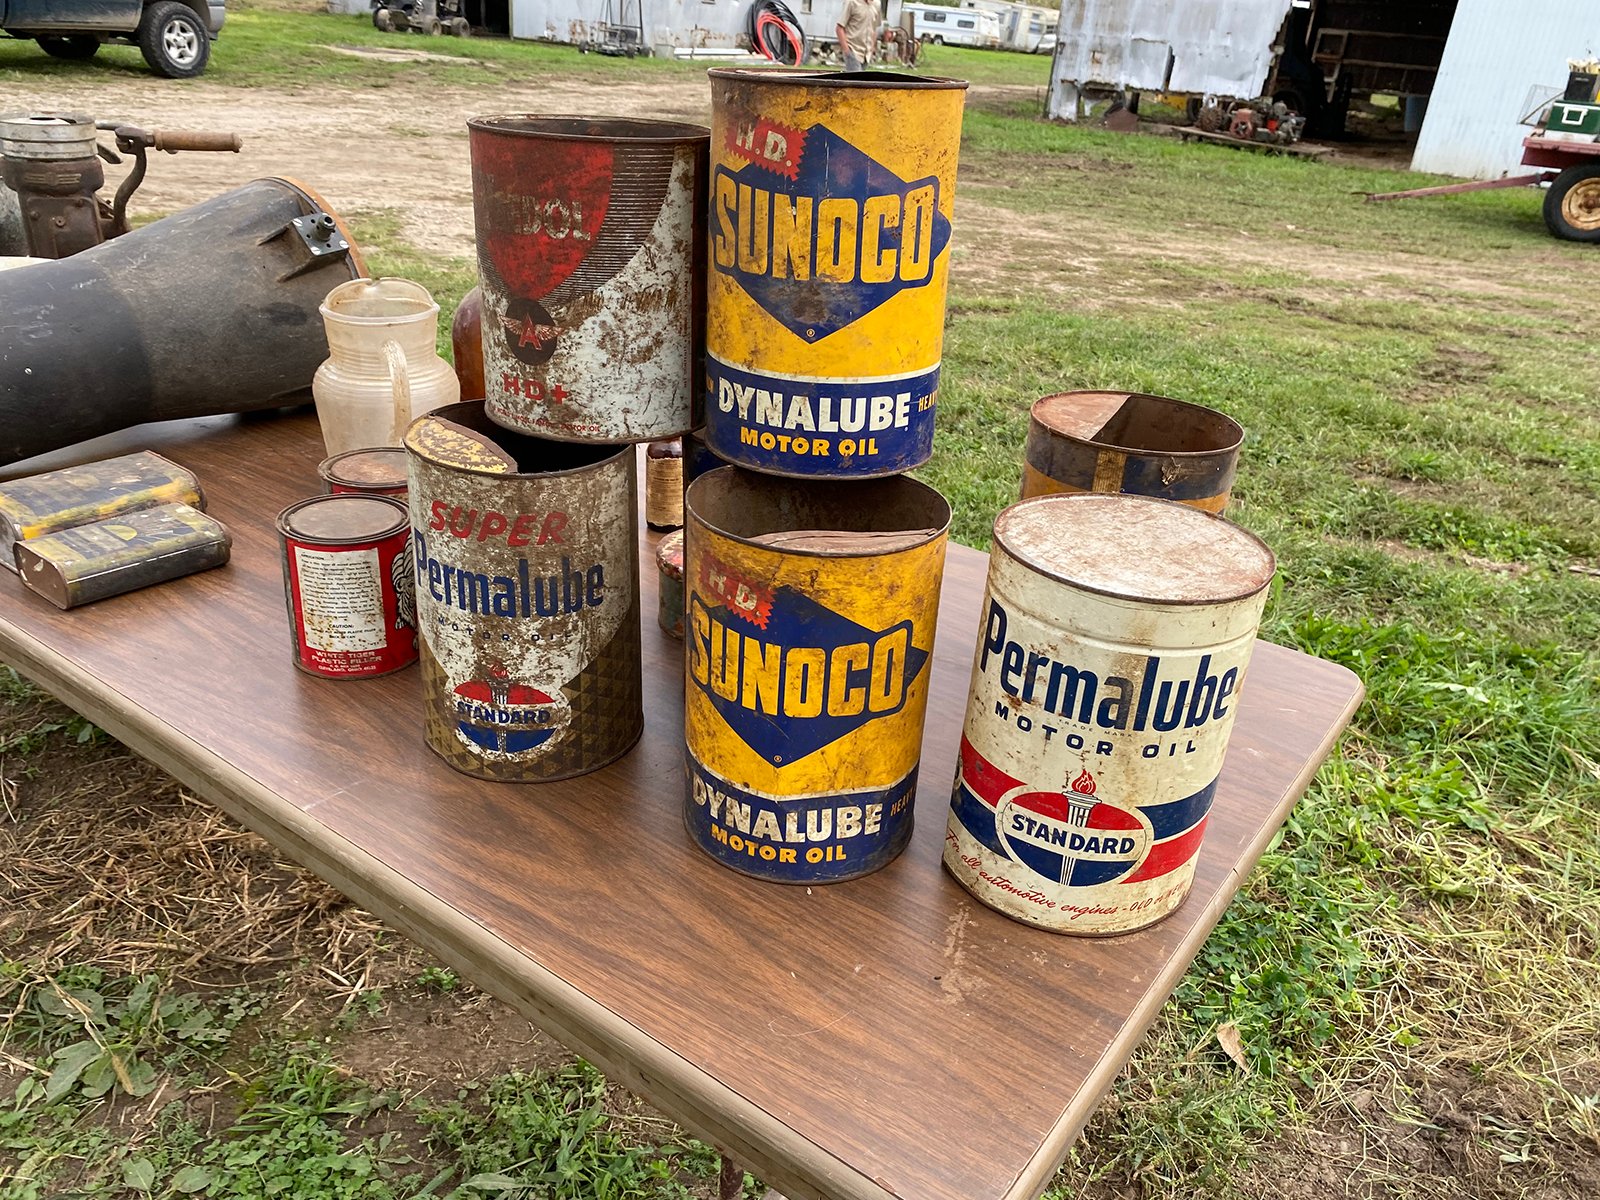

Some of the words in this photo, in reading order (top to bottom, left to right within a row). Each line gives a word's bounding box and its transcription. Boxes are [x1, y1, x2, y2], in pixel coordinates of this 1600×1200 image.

[735, 119, 792, 167] H.D.
[714, 176, 935, 284] SUNOCO
[719, 376, 911, 433] DYNALUBE
[740, 427, 830, 457] MOTOR
[838, 438, 879, 458] OIL
[429, 500, 570, 547] SUPER
[414, 528, 605, 618] Permalube
[708, 568, 762, 616] H.D.
[438, 616, 510, 642] MOTOR
[312, 655, 347, 664] PLASTIC
[350, 656, 382, 664] FILLER
[347, 651, 375, 659] TIGER
[690, 599, 908, 718] SUNOCO
[980, 597, 1239, 734] Permalube
[456, 700, 551, 724] STANDARD
[995, 701, 1114, 757] MOTOR
[1142, 739, 1196, 759] OIL
[1058, 718, 1094, 733] TRADE
[1103, 729, 1133, 739] MARK
[692, 772, 883, 843] DYNALUBE
[711, 824, 797, 863] MOTOR
[805, 844, 847, 863] OIL
[1011, 814, 1137, 856] STANDARD
[946, 827, 960, 853] For
[961, 853, 982, 870] all
[979, 870, 1056, 908] automotive
[1061, 902, 1118, 920] engines
